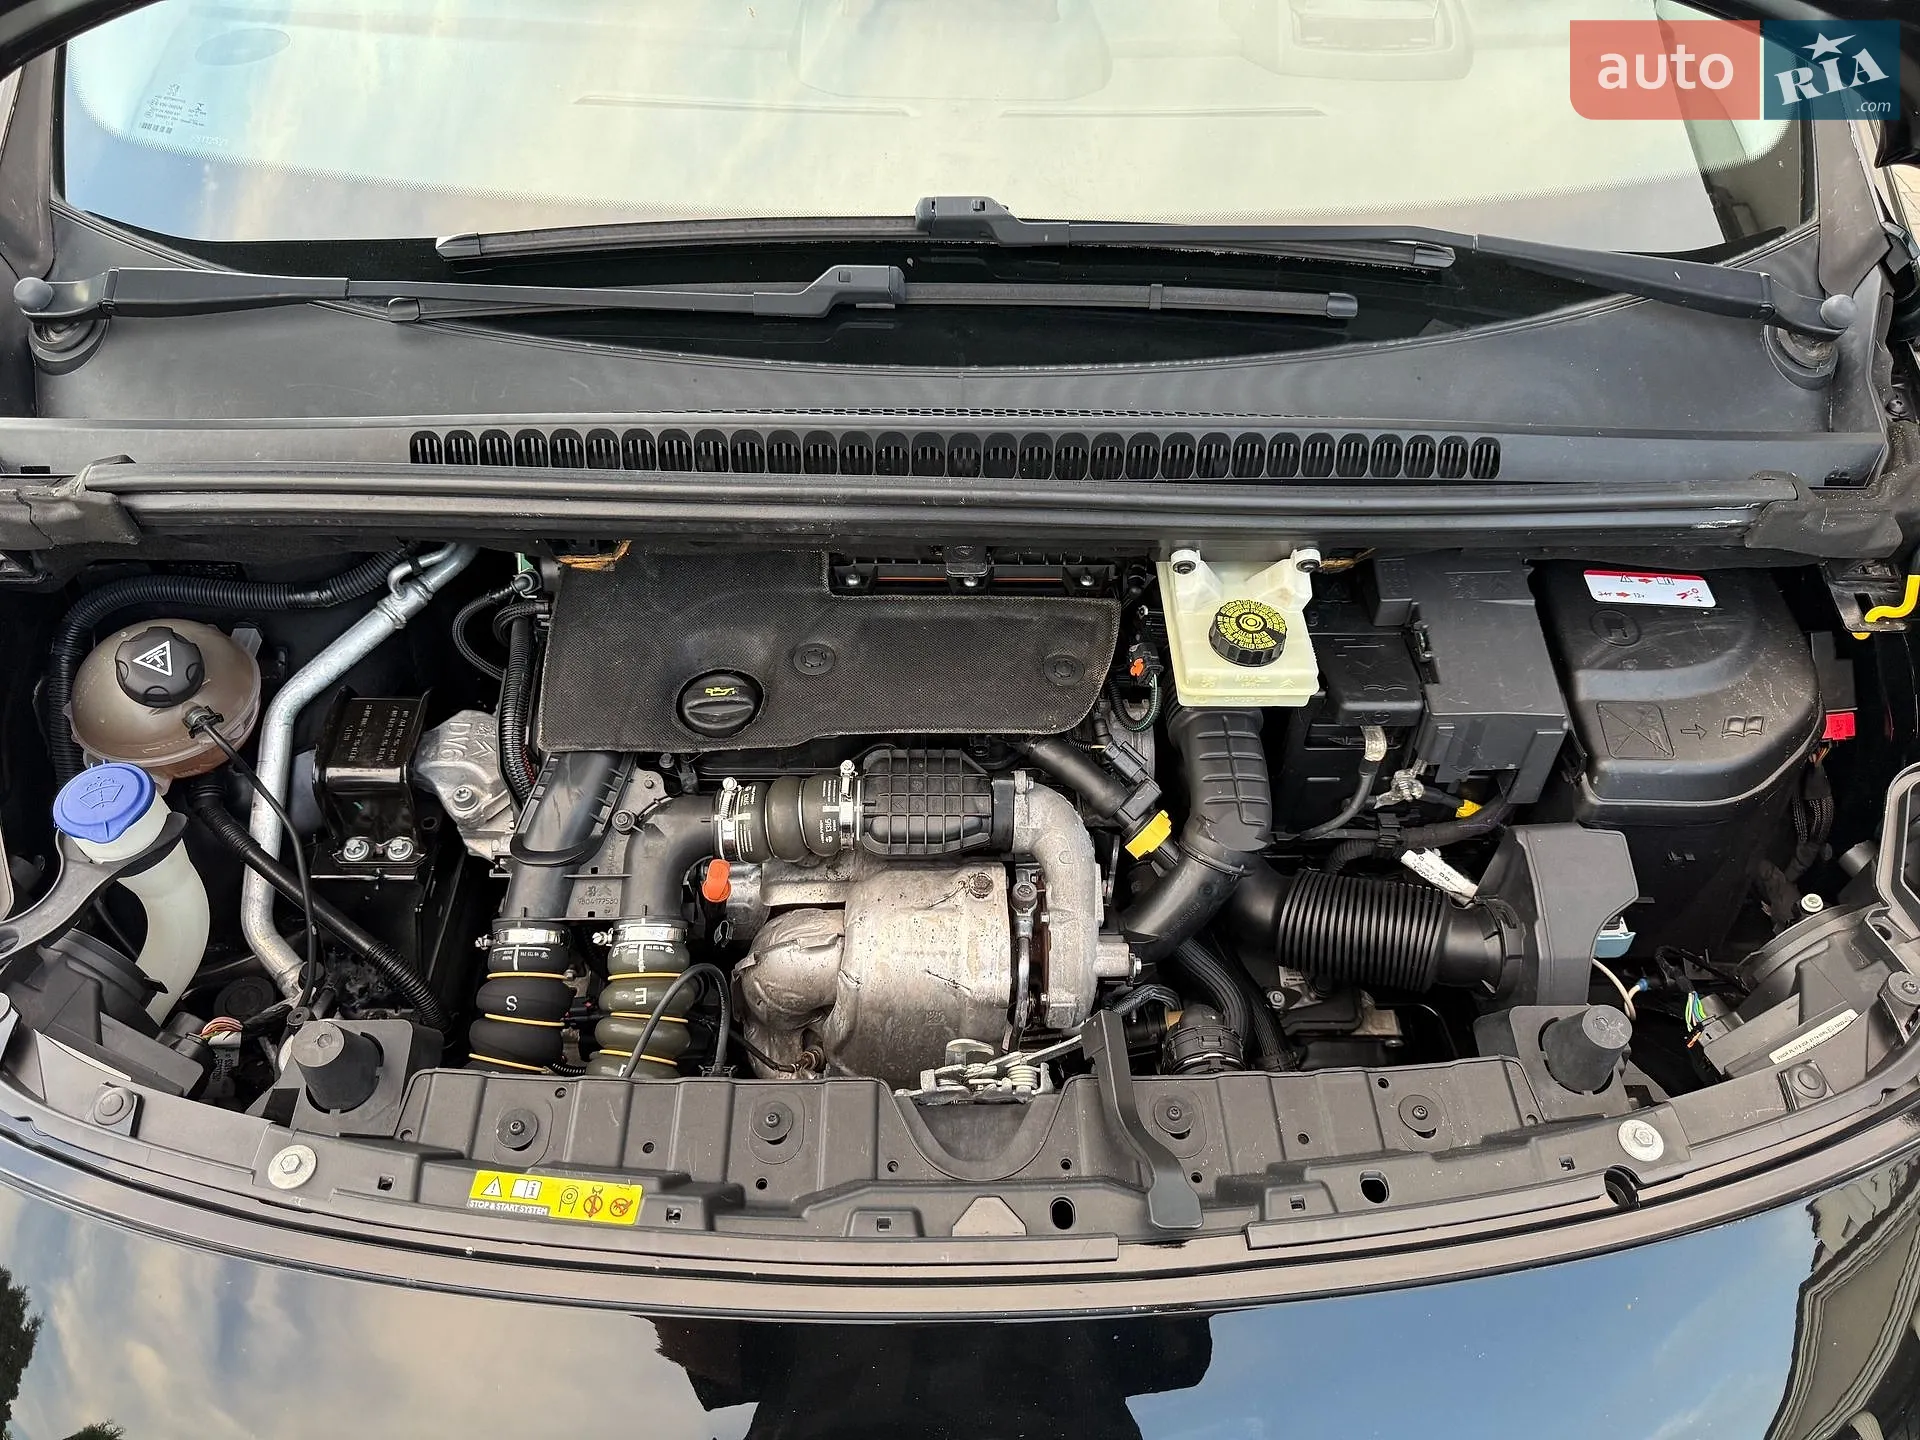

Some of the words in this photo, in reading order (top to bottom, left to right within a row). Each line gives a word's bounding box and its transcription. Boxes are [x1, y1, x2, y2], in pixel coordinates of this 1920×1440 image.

[506, 995, 518, 1011] S
[634, 987, 648, 1005] E
[469, 1200, 489, 1209] STOP
[496, 1203, 520, 1213] START
[519, 1206, 548, 1216] SYSTEM
